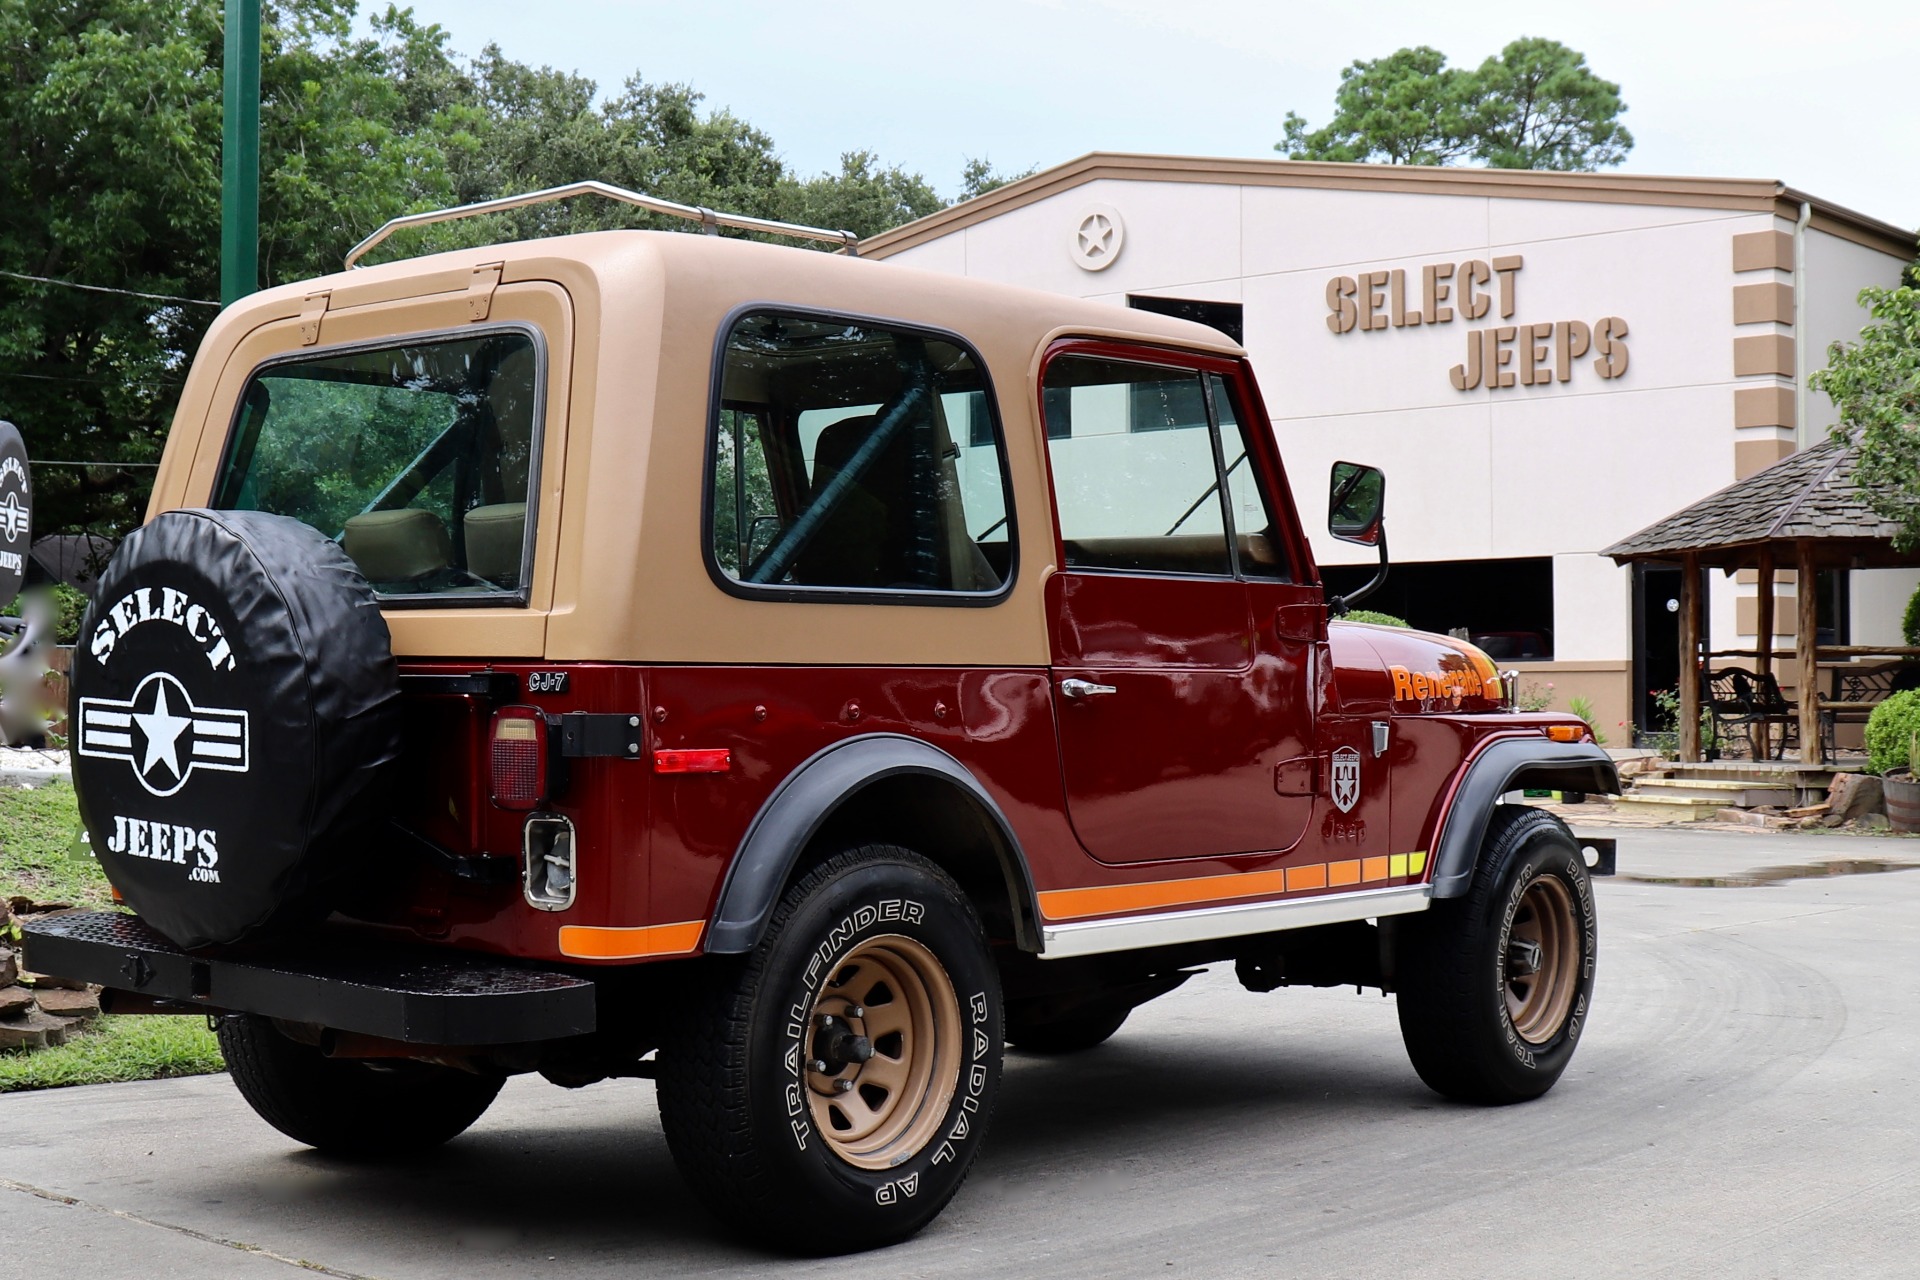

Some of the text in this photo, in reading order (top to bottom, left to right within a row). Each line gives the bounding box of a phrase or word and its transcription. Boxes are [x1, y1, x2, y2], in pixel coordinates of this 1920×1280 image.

[1326, 255, 1523, 333] SELECT
[1449, 317, 1629, 390] JEEPS
[91, 587, 236, 671] SELECT
[529, 672, 566, 692] CJ-7
[1389, 664, 1482, 707] Renegade
[107, 815, 219, 868] JEEPS
[188, 867, 221, 883] .COM
[1566, 858, 1595, 979] RADIAL
[930, 992, 989, 1166] RADIAL
[875, 1171, 919, 1206] AP
